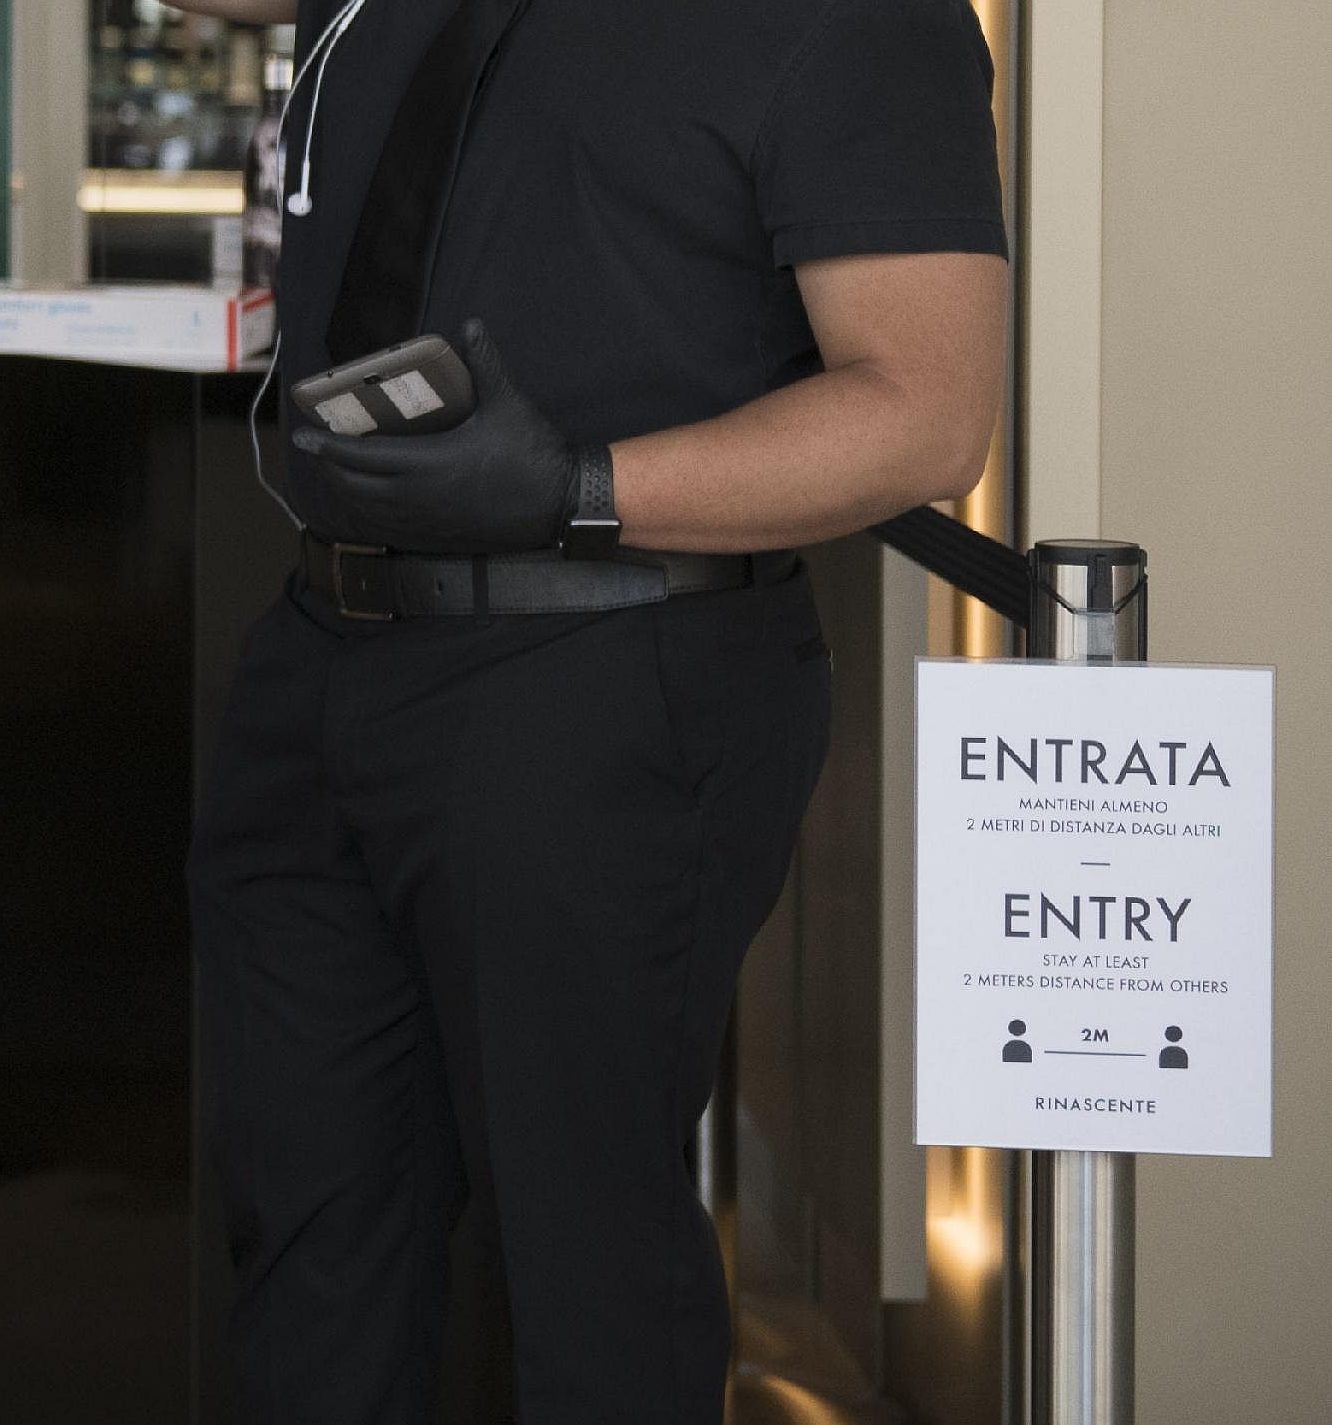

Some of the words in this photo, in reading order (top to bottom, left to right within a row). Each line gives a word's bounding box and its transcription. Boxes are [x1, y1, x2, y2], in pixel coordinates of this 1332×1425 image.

[960, 735, 1232, 788] ENTRATA
[1019, 798, 1095, 812] MANTIENI
[1100, 800, 1168, 814] ALMENO
[966, 818, 975, 831] 2
[981, 818, 1024, 832] METRI
[1030, 819, 1045, 832] DI
[1050, 819, 1127, 834] DISTANZA
[1131, 822, 1176, 836] DAGLI
[1182, 824, 1221, 838] ALTRI
[1004, 891, 1192, 943] ENTRY
[1043, 953, 1078, 967] STAY
[1082, 955, 1101, 968] AT
[1106, 955, 1149, 969] LEAST
[963, 973, 972, 986] 2
[978, 974, 1034, 988] METERS
[1039, 975, 1115, 991] DISTANCE
[1119, 978, 1164, 992] FROM
[1170, 979, 1228, 994] OTHERS
[1080, 1027, 1109, 1043] 2M
[1035, 1096, 1156, 1114] RINASCENTE
